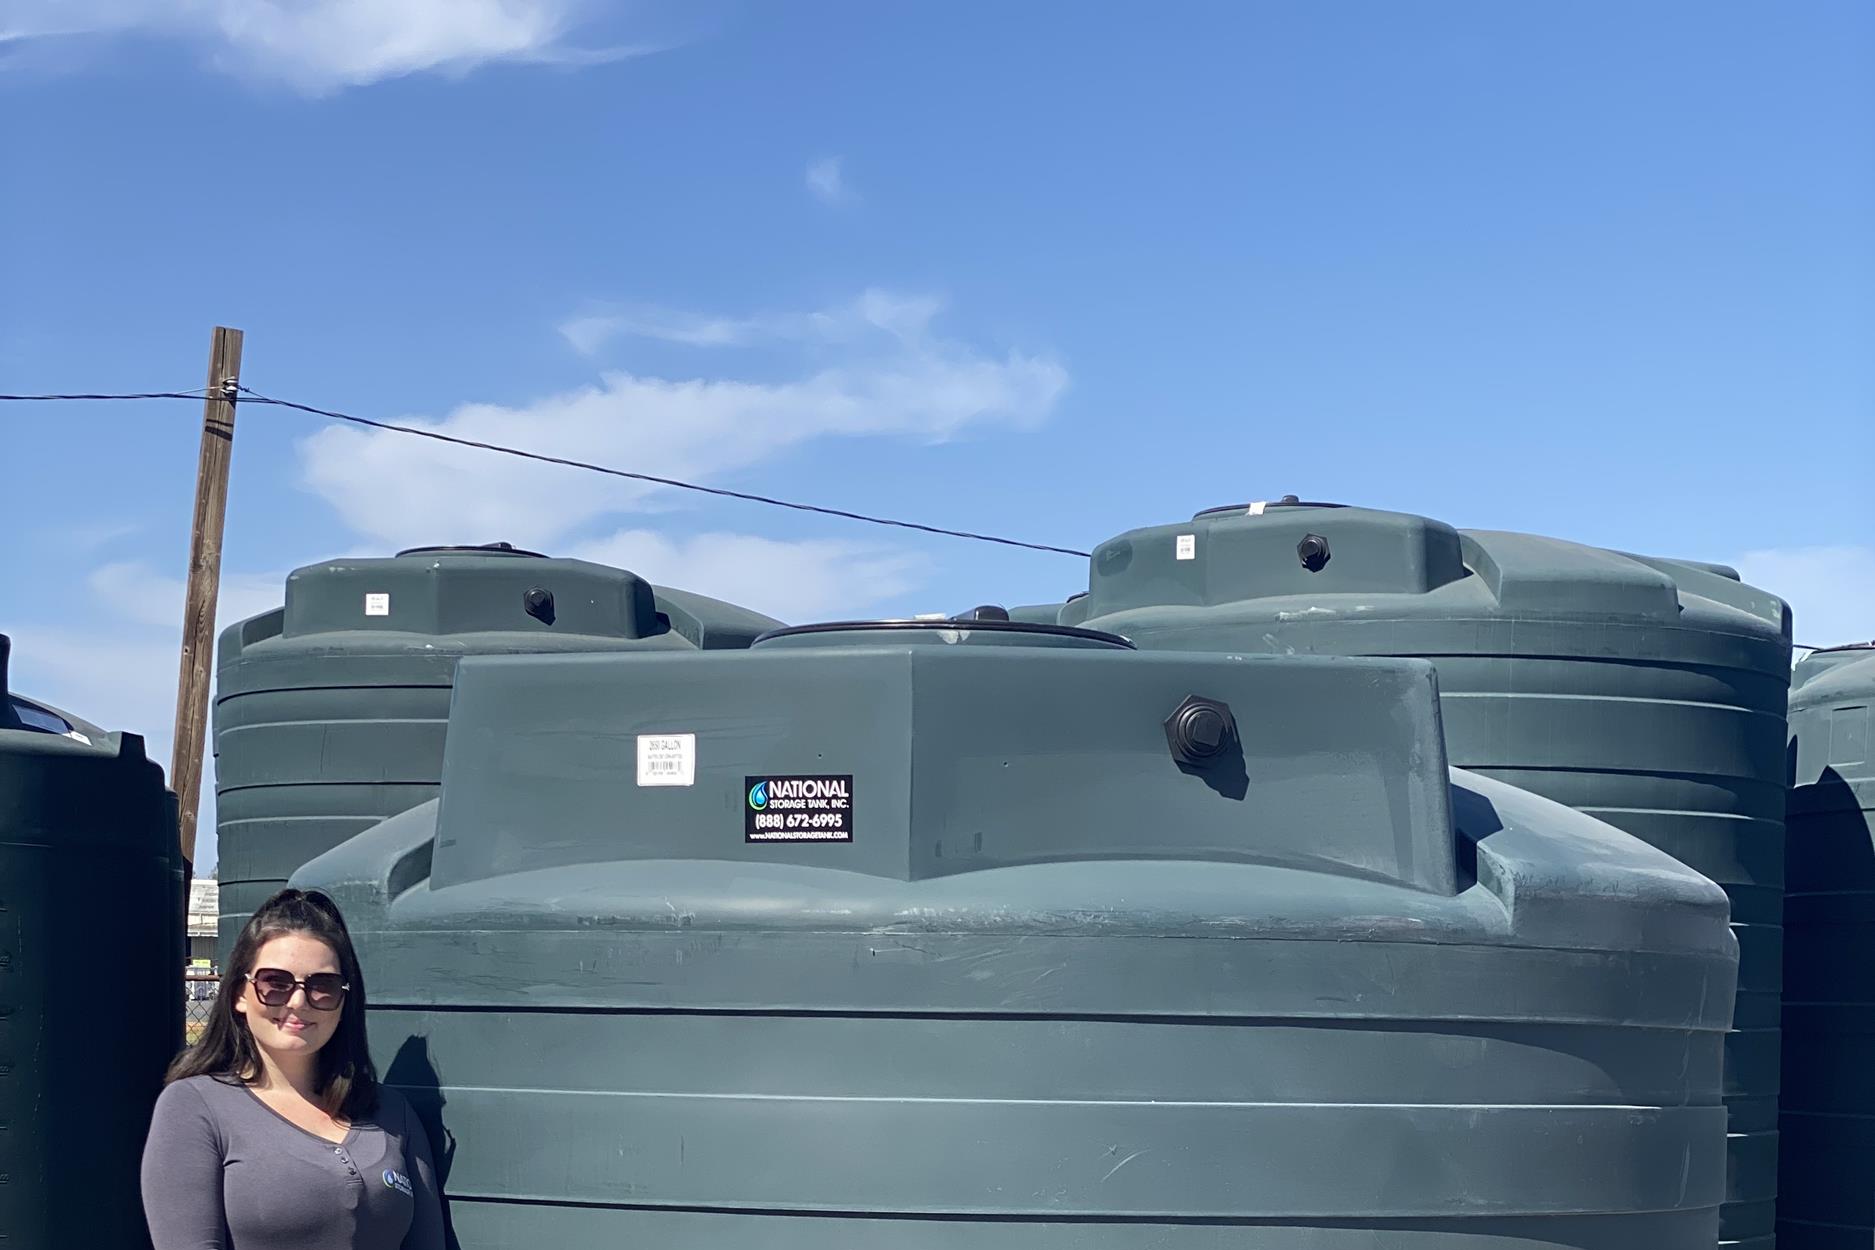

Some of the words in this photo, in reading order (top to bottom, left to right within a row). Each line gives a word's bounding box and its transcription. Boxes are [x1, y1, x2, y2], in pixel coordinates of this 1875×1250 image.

[769, 780, 849, 798] NATIONAL
[769, 799, 807, 809] STORAGE
[807, 799, 830, 810] TANK,
[831, 798, 850, 809] INC.
[755, 813, 784, 830] (888)
[786, 813, 843, 828] 672-6995
